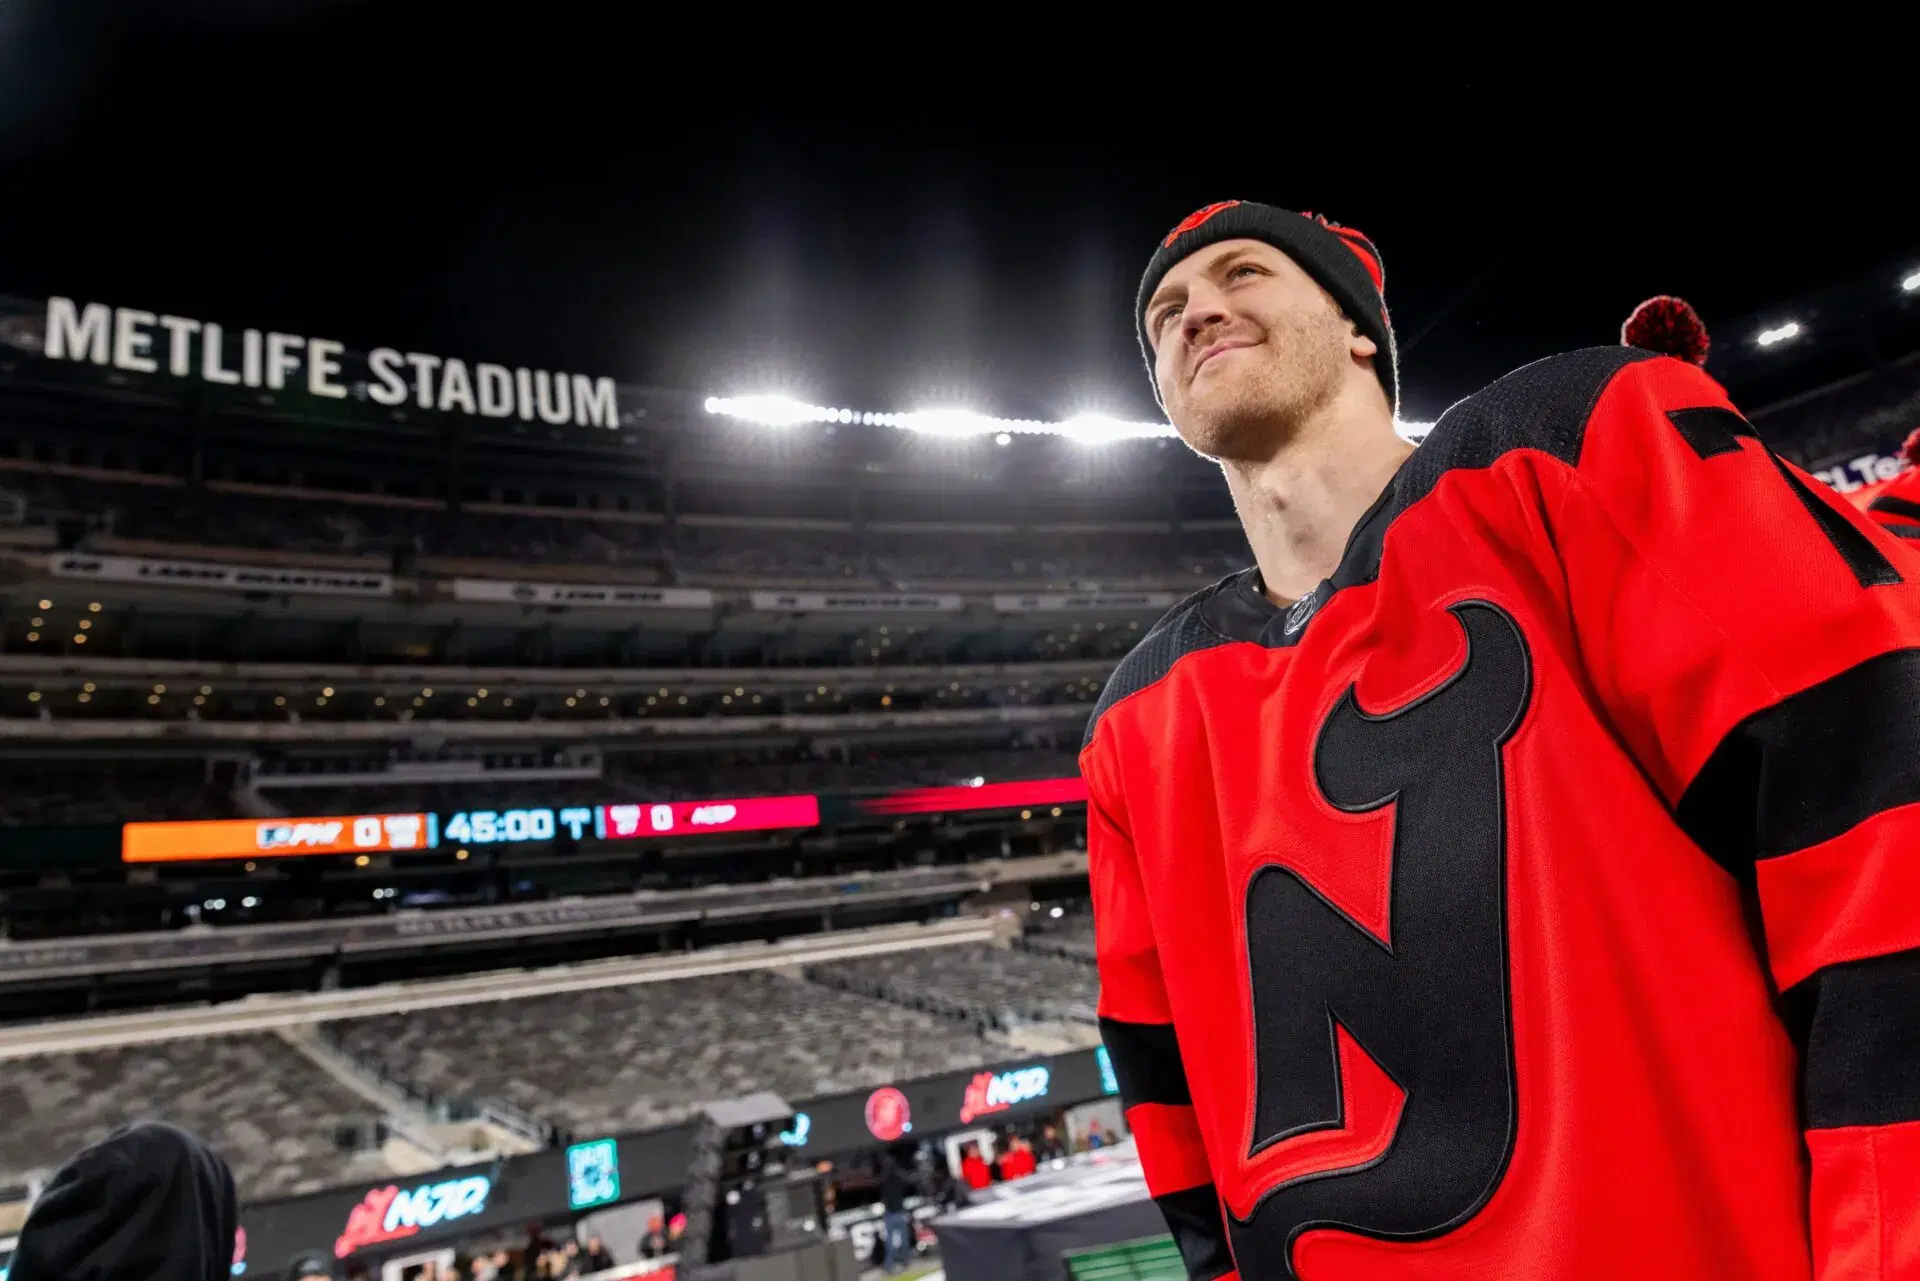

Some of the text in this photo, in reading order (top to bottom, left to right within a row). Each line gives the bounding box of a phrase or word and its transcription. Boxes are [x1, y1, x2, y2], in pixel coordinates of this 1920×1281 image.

[44, 296, 619, 429] METLIFE STADIUM
[353, 817, 381, 847] 0
[444, 808, 556, 844] 45:00
[650, 804, 674, 831] 0
